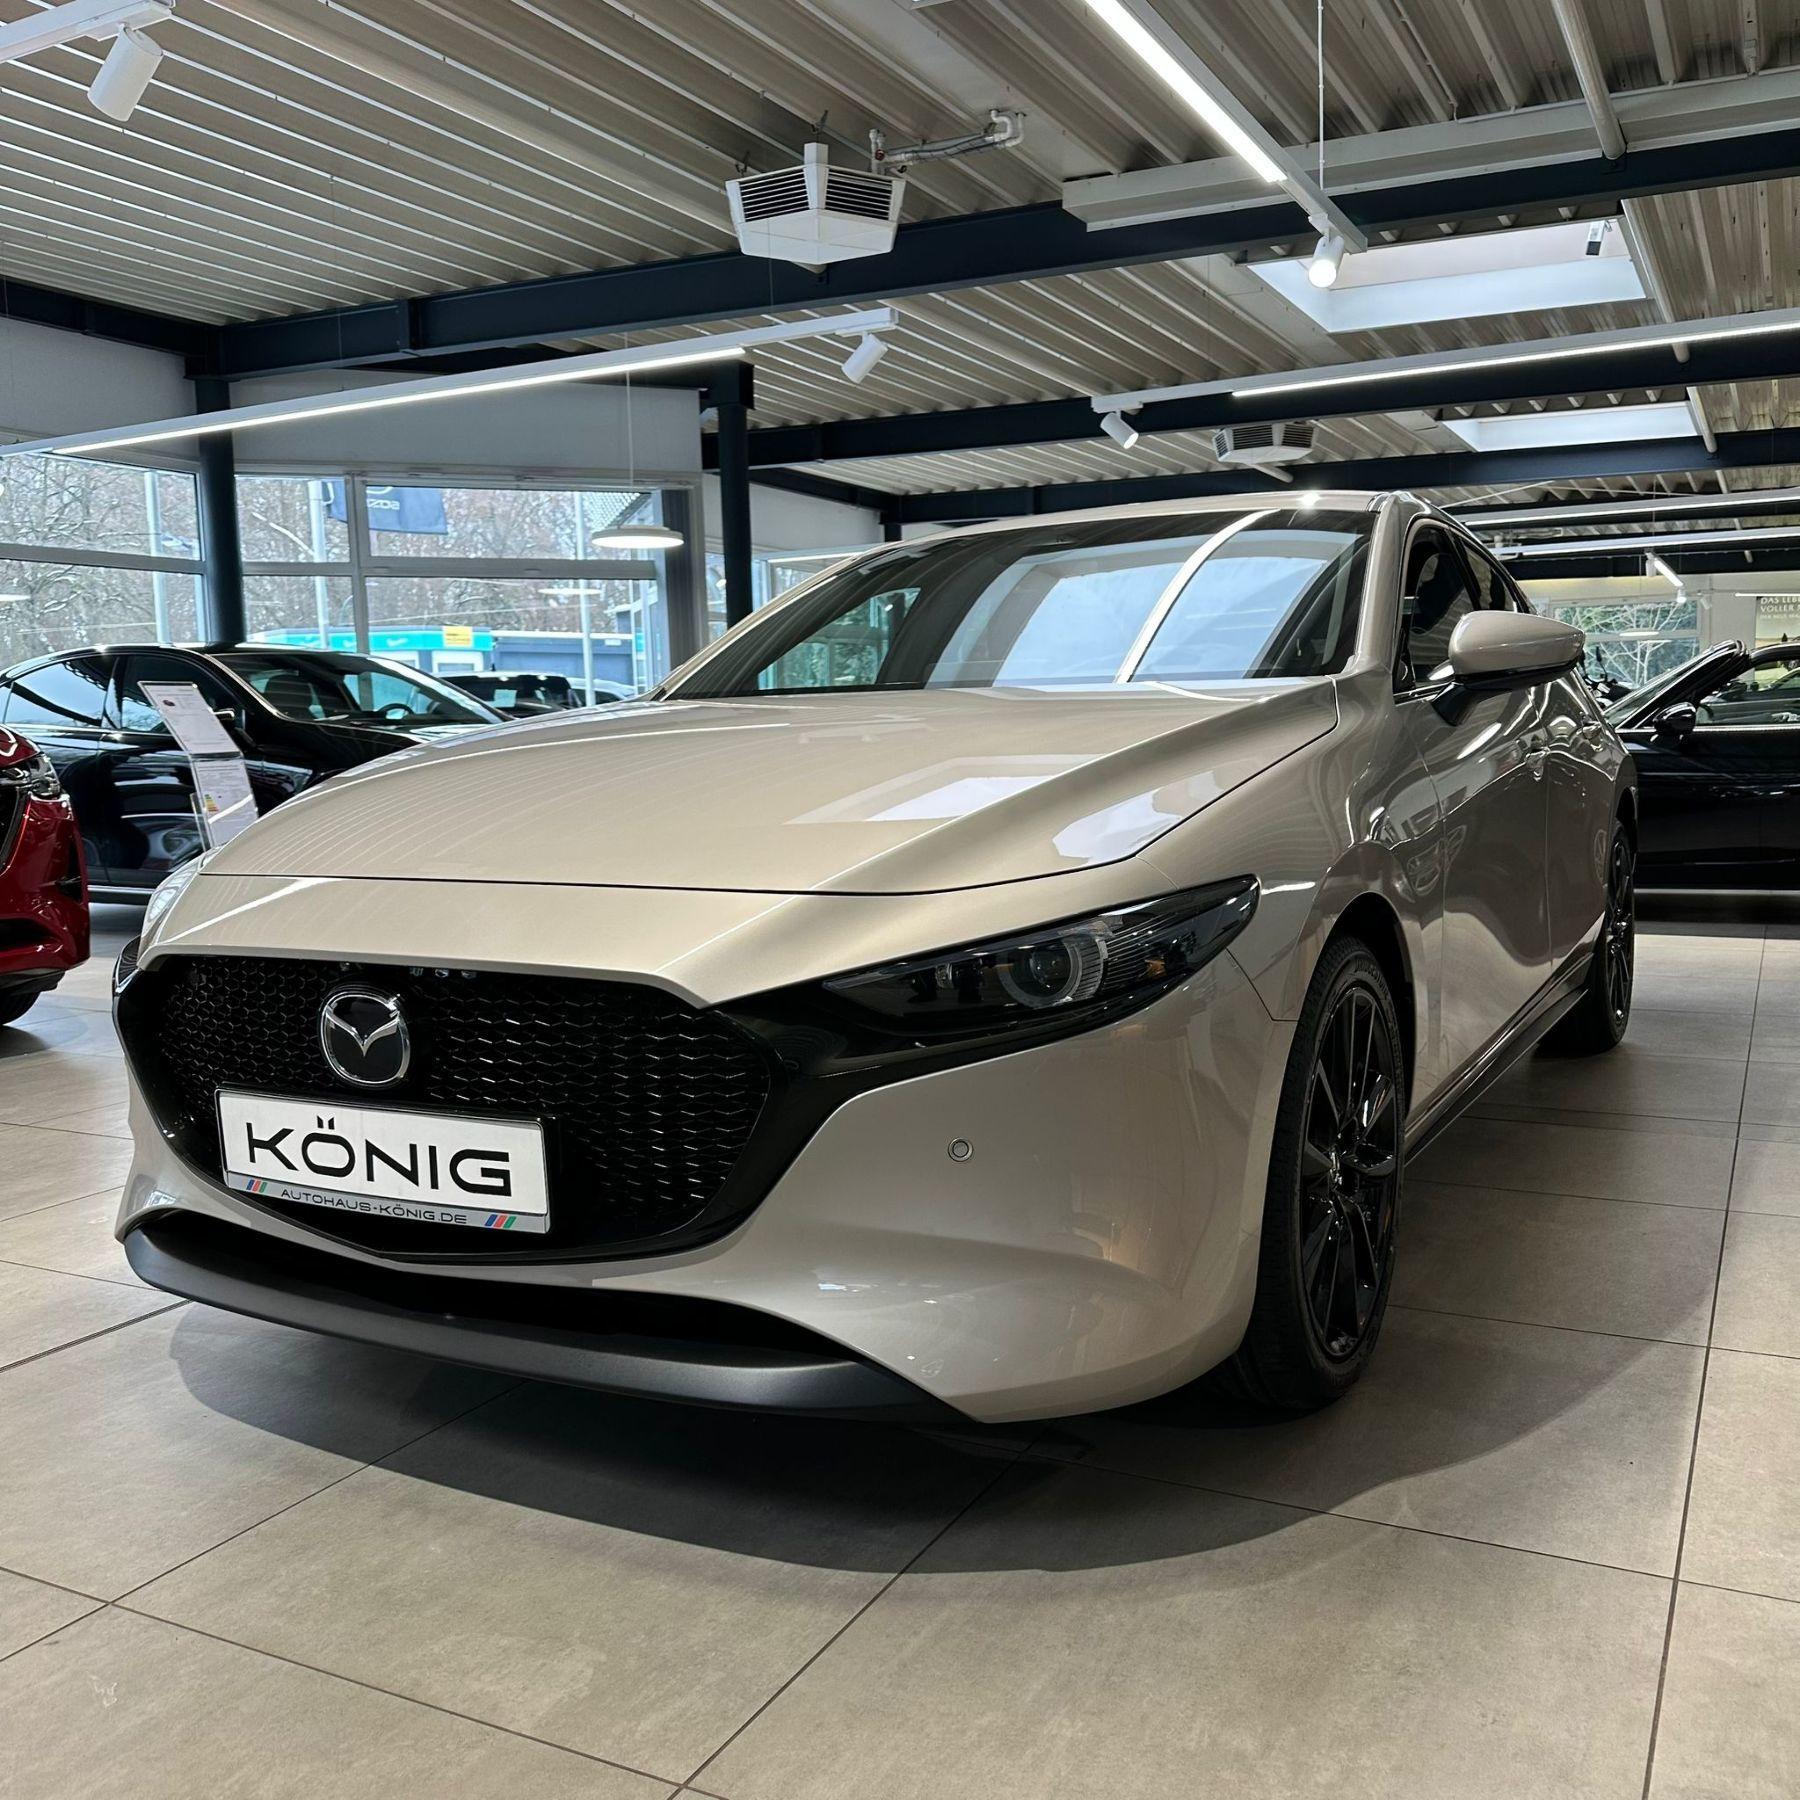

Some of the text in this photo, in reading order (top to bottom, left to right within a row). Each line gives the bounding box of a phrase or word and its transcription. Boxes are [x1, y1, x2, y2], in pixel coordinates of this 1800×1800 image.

[1760, 597, 1779, 605] DAS
[246, 1115, 512, 1197] KÖNIG
[280, 1189, 468, 1225] AUTOHAUS-KÖNIG.DE
